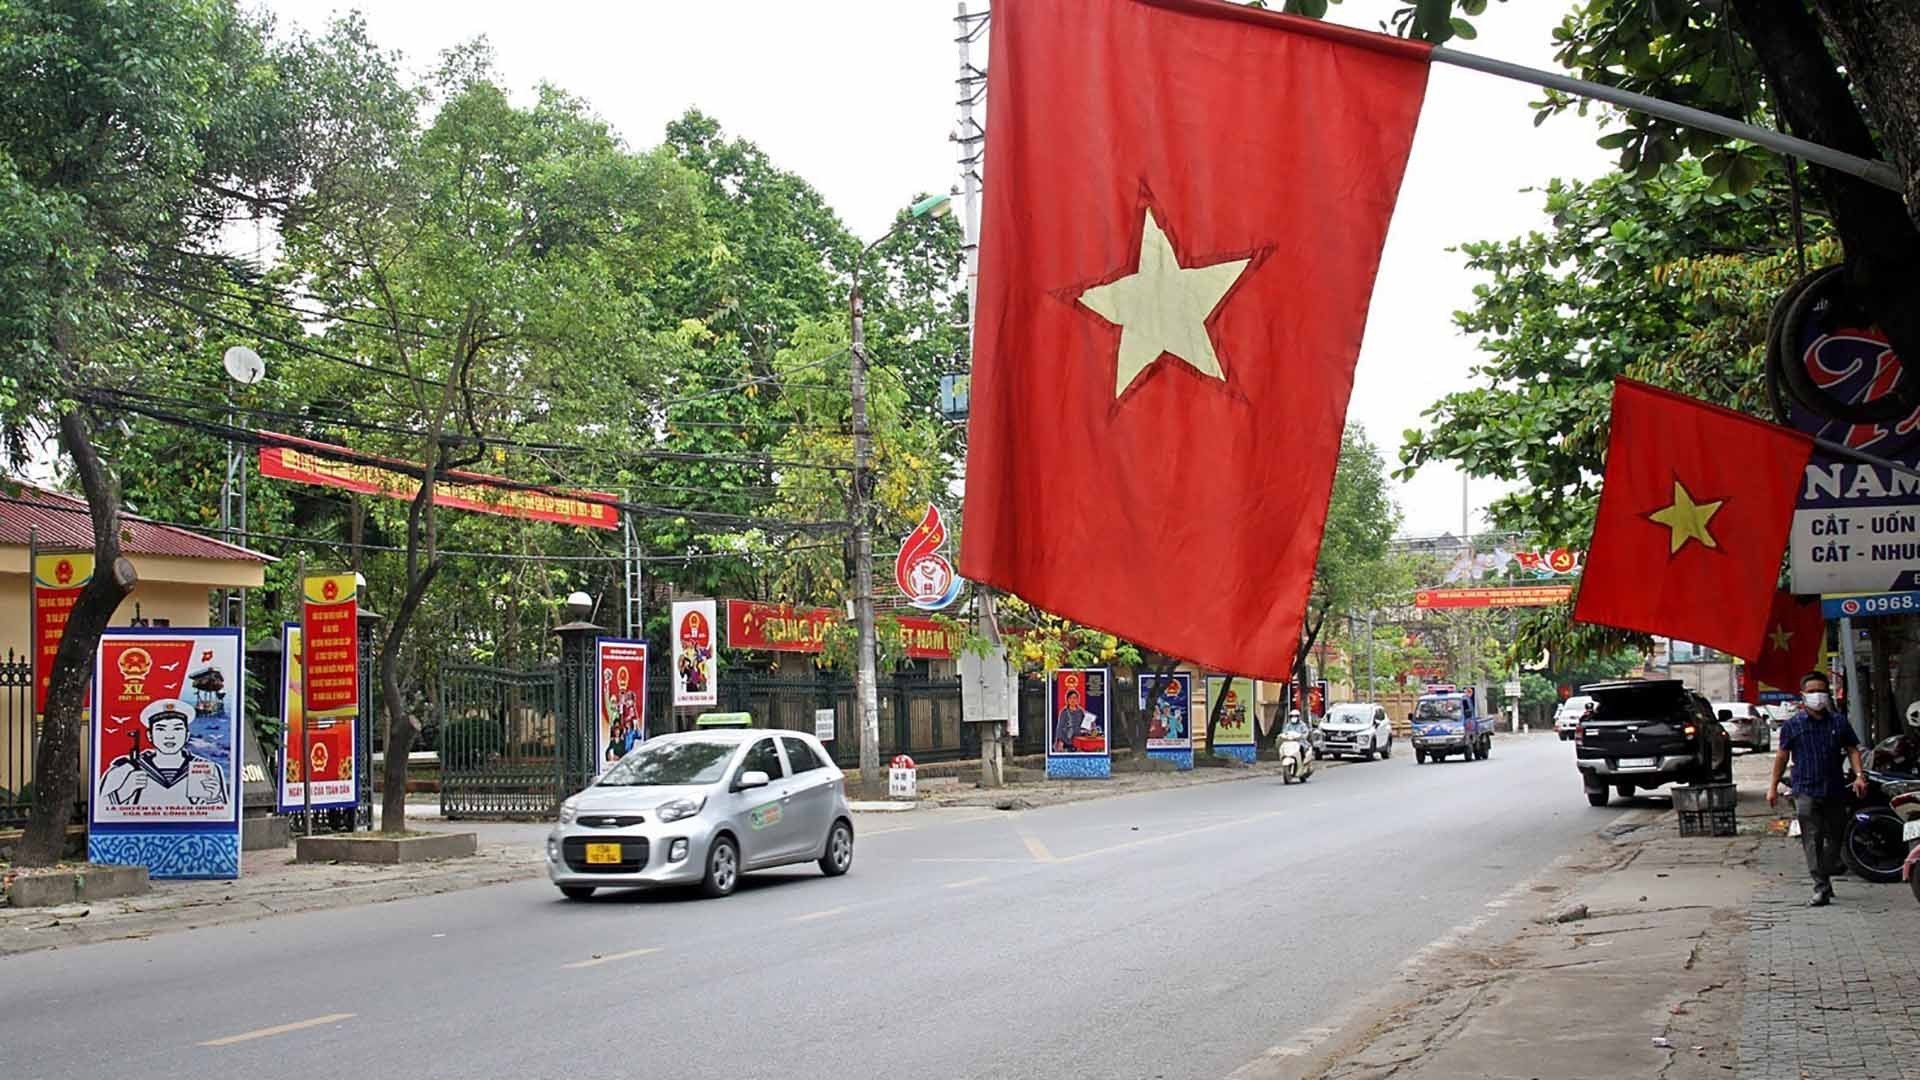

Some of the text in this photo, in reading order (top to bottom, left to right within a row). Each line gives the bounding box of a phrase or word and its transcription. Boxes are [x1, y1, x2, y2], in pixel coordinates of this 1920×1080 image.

[1811, 513, 1850, 536] CẮT
[1871, 510, 1916, 534] UỐN
[1811, 540, 1850, 563] CẮT
[1871, 543, 1920, 561] NHU
